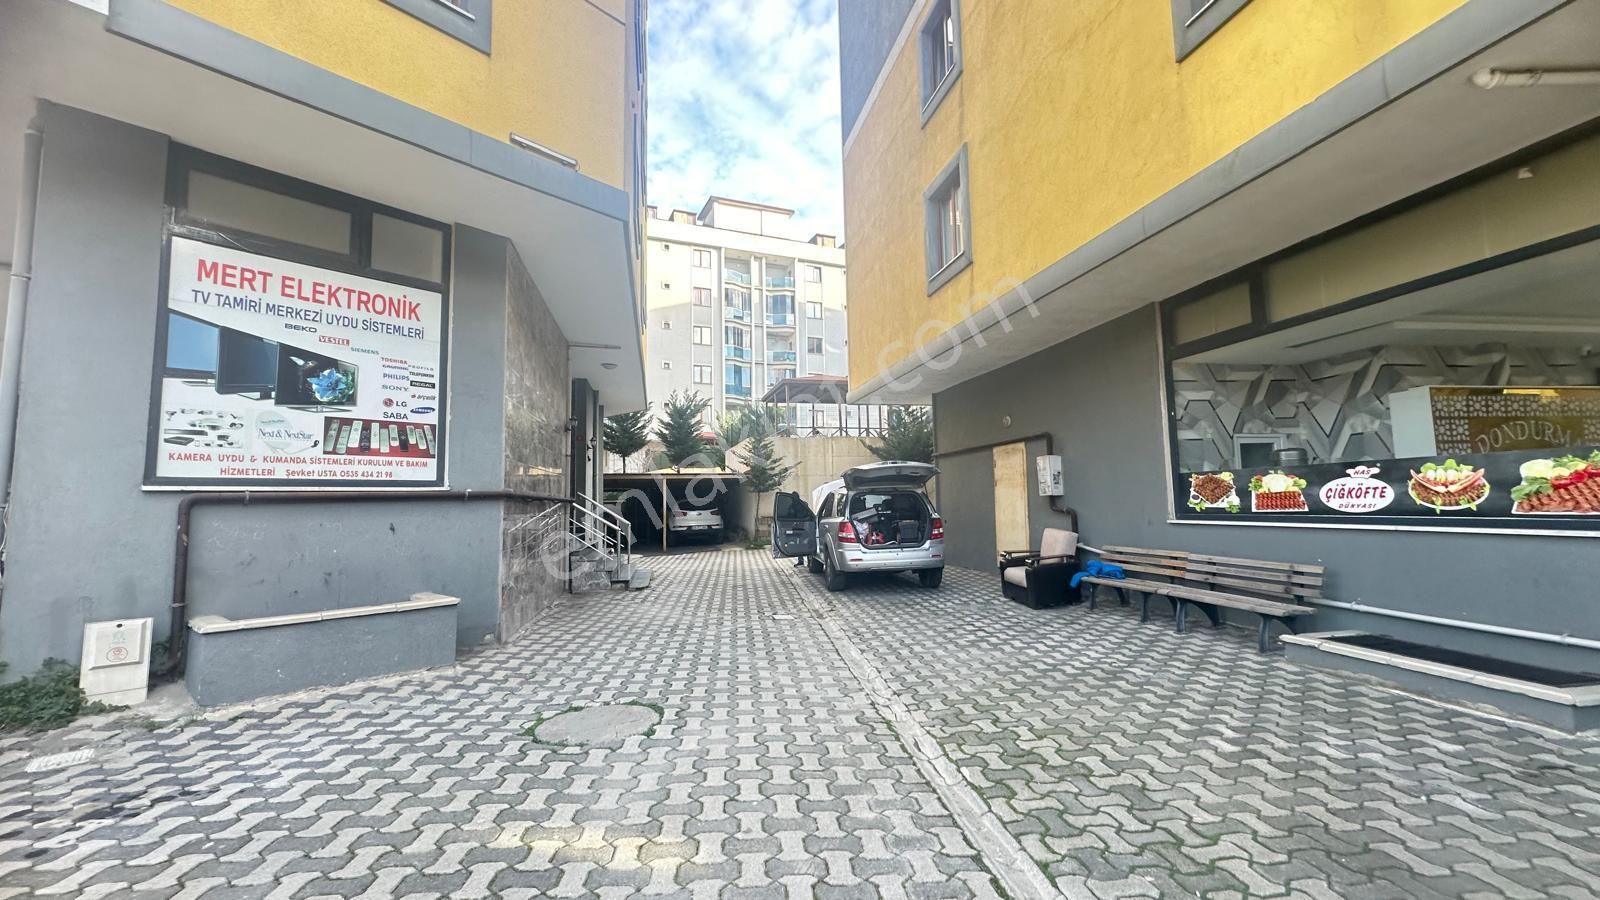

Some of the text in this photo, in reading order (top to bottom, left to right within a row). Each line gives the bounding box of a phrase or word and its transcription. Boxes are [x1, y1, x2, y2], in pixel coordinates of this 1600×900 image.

[197, 258, 421, 321] MERT ELEKTRONİK
[192, 289, 424, 340] TV TAMİRİ MERKEZİ UYDU SİSTEMLERİ
[284, 323, 317, 333] BEKO
[319, 336, 349, 347] VESTEL
[350, 347, 380, 355] SIEMENS
[381, 357, 408, 365] TOSHIBA
[383, 373, 410, 381] PHILIPS
[383, 412, 409, 420] SABA
[1474, 420, 1582, 454] DONDURM
[168, 452, 212, 462] KAMERA
[218, 454, 245, 462] UYDU
[249, 455, 257, 463] &
[263, 455, 307, 464] KUMANDA
[309, 456, 355, 466] SİSTEMLERİ
[220, 465, 276, 476] HİZMETLERİ
[285, 468, 315, 478] Şevket
[1325, 482, 1388, 503] ÇİĞKÖFTE
